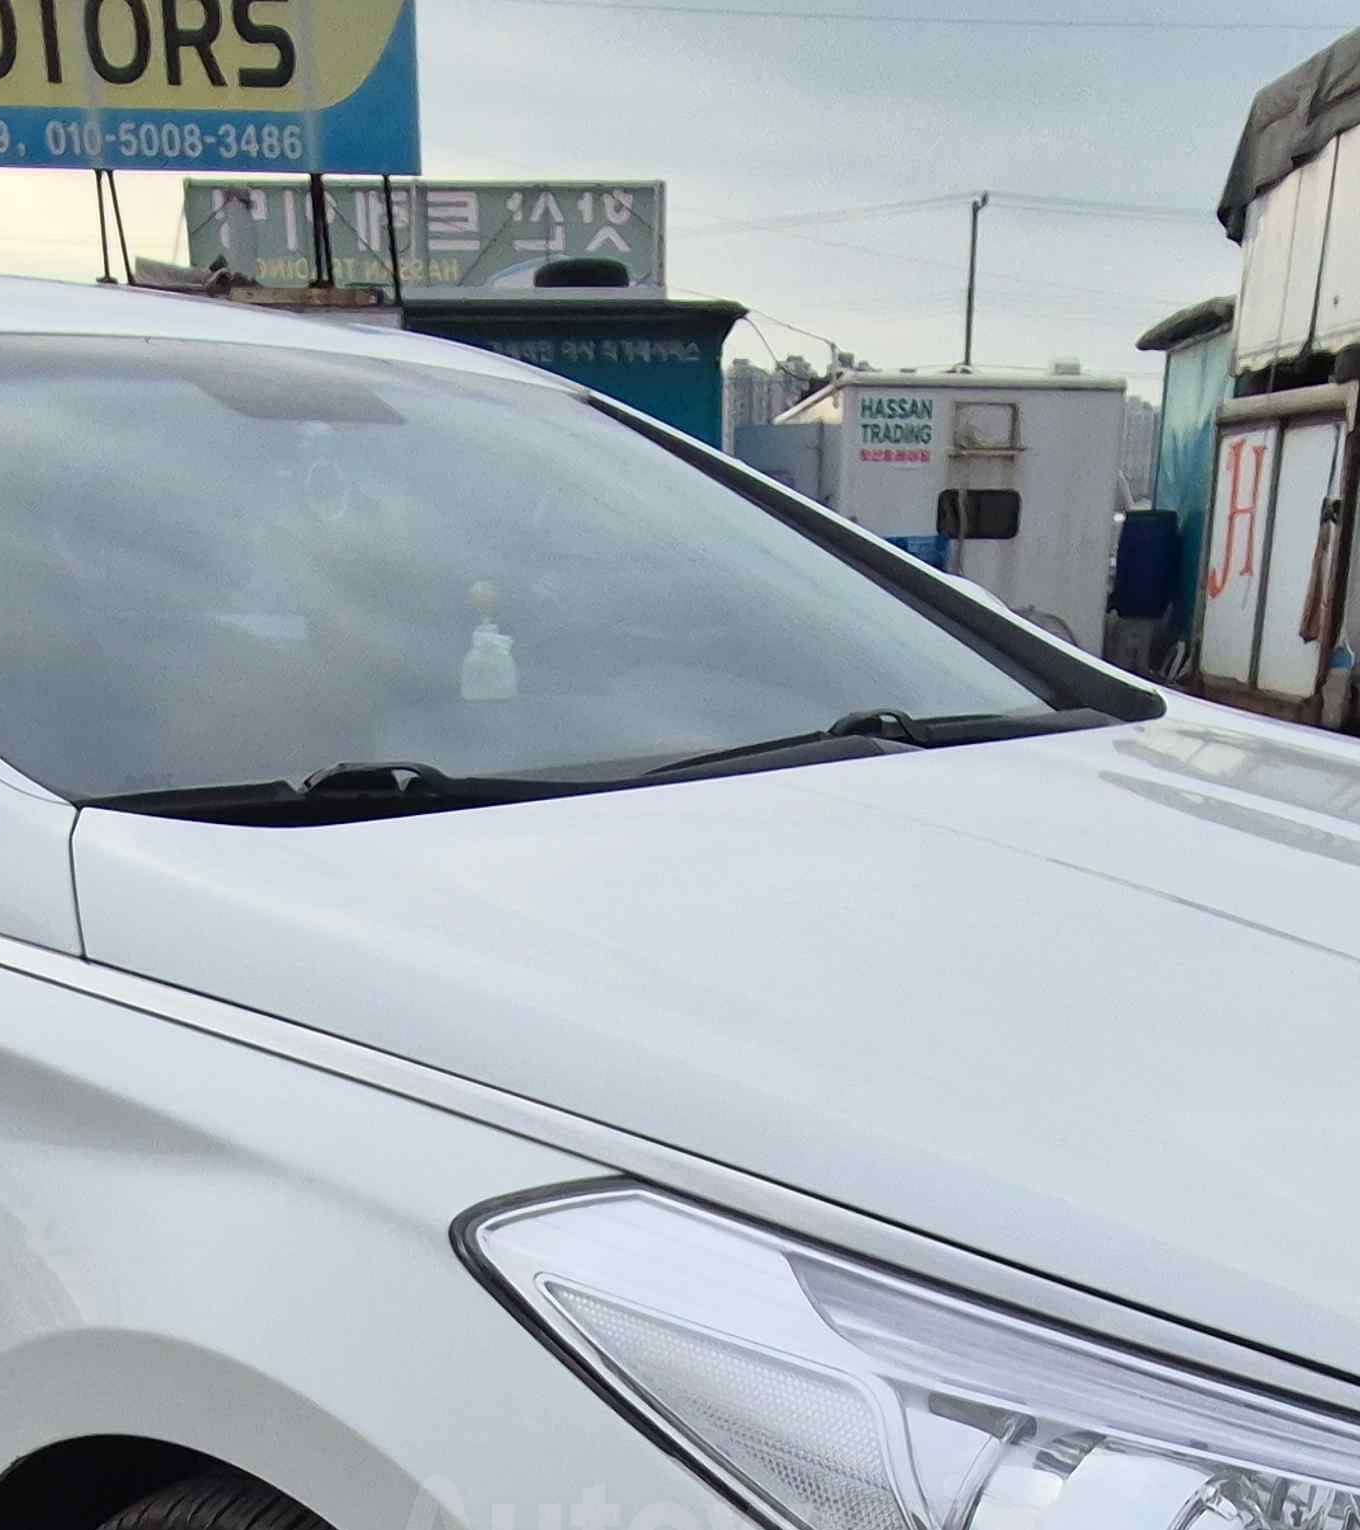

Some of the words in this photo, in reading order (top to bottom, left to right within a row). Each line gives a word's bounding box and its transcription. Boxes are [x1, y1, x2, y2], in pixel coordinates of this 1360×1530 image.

[45, 120, 304, 160] 010-5008-3486
[860, 398, 934, 419] HASSAN
[861, 423, 933, 445] TRADING
